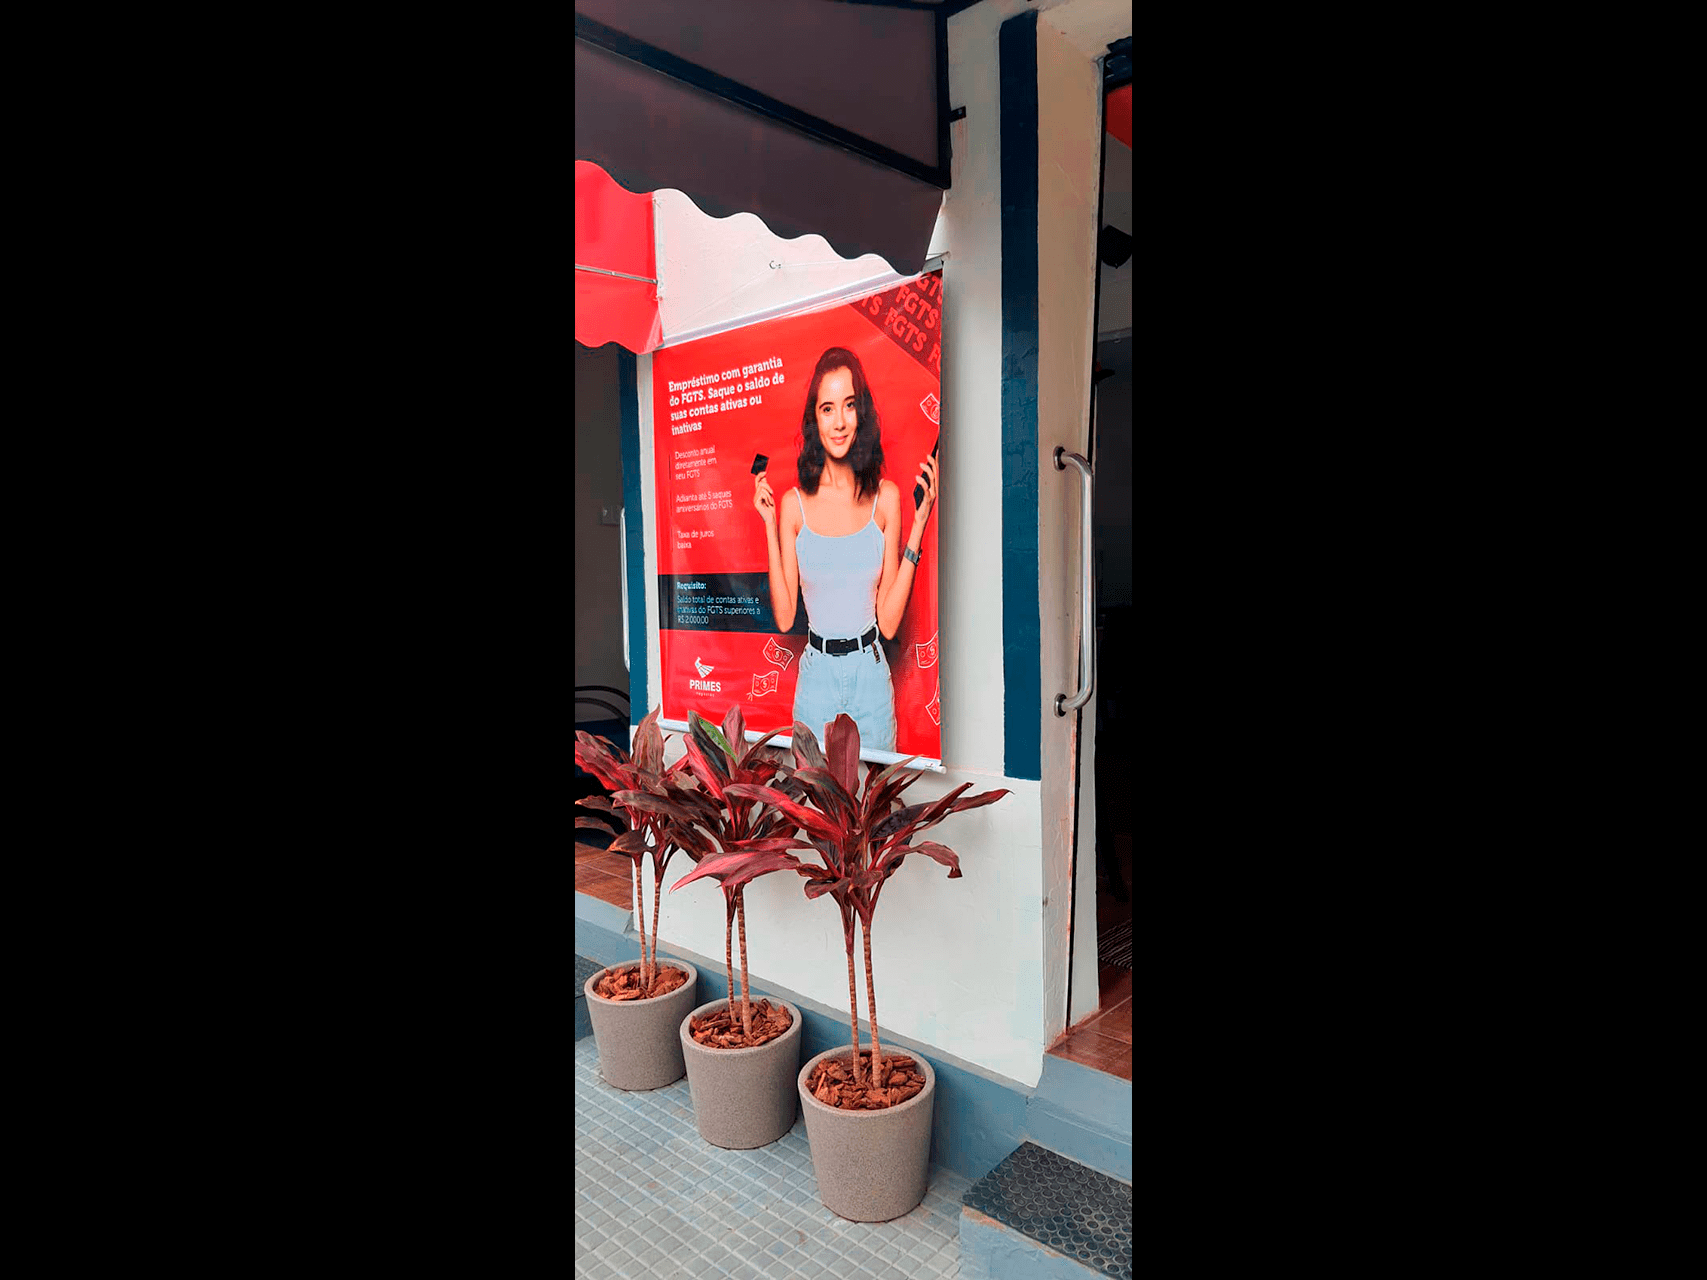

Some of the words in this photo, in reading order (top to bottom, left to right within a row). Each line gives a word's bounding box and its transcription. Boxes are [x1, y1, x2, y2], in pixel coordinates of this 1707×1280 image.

[895, 285, 939, 329] FGTS
[884, 307, 927, 351] FGTS
[668, 374, 719, 392] Empréstimo
[721, 369, 740, 380] com
[743, 357, 783, 378] garantia
[669, 395, 680, 406] do
[681, 391, 706, 405] FGTS.
[707, 387, 735, 401] Saque
[736, 384, 743, 393] o
[744, 377, 771, 391] saldo
[772, 372, 785, 386] de
[670, 409, 688, 421] suas
[689, 403, 718, 417] contas
[720, 397, 747, 411] ativas
[749, 394, 762, 406] ou
[672, 422, 702, 435] inativas
[674, 449, 700, 460] Desconto
[700, 445, 715, 456] anual
[674, 459, 707, 470] diretamente
[675, 472, 686, 480] seu
[686, 469, 701, 479] FGTS
[707, 491, 711, 499] 5
[712, 490, 733, 500] saques
[709, 501, 718, 510] do
[718, 499, 733, 509] FGTS
[676, 530, 690, 539] Taxa
[690, 529, 699, 538] de
[699, 529, 715, 540] juros
[676, 540, 692, 550] baixa
[676, 581, 707, 591] Requisito:
[676, 595, 692, 605] Saldo
[692, 594, 706, 604] total
[705, 595, 715, 605] de
[715, 595, 736, 604] contas
[737, 595, 754, 604] ativas
[754, 596, 760, 604] e
[697, 605, 707, 614] do
[706, 605, 724, 615] FGTS
[723, 606, 756, 615] superiores
[756, 607, 761, 615] a
[677, 615, 685, 624] R$
[689, 679, 721, 692] PRIMES
